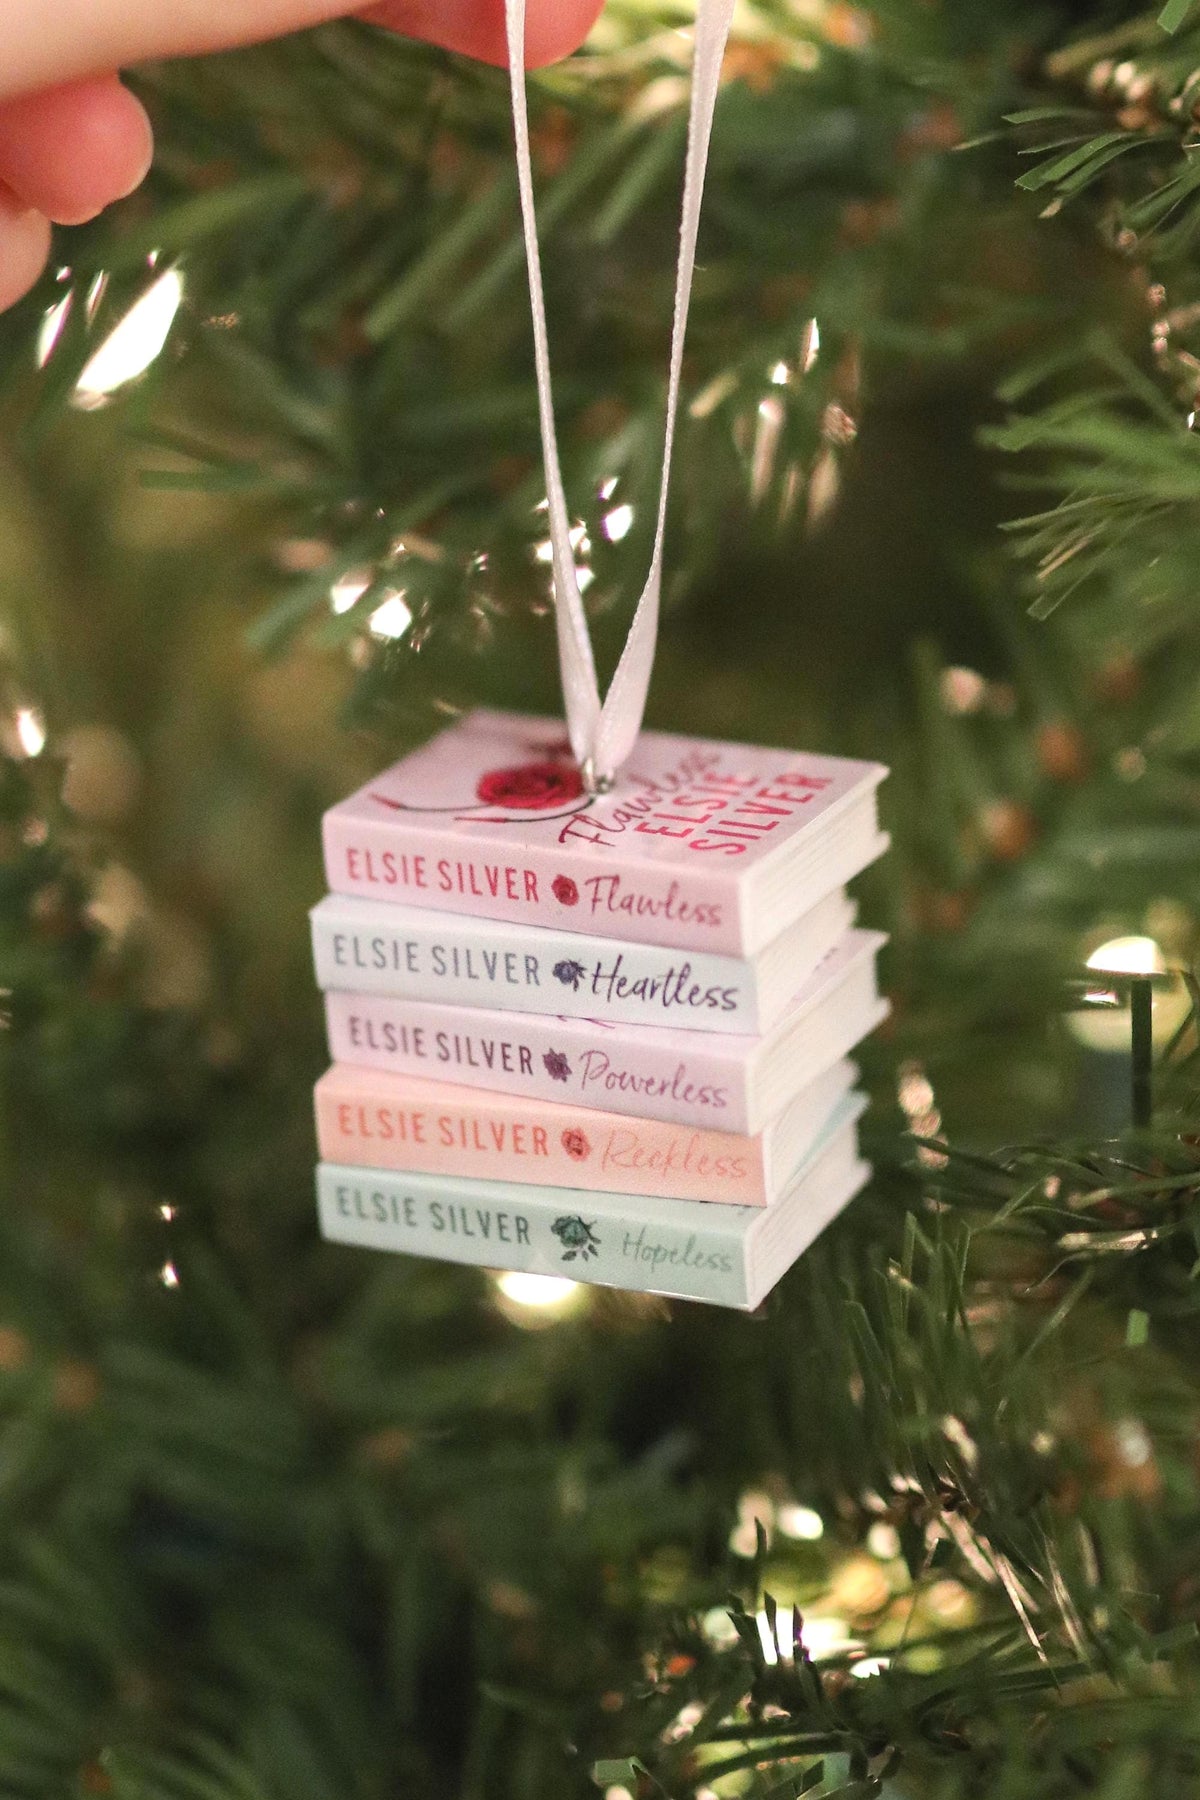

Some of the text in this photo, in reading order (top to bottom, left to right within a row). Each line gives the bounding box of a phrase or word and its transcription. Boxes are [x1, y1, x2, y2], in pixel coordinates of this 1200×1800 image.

[633, 771, 761, 839] ELSIE
[688, 772, 834, 856] SILVER
[346, 847, 722, 926] ELSIE SILVER Flawless
[333, 934, 739, 1012] ELSIE SILVER Heartless
[348, 1016, 729, 1109] ELSIE SILVER Powerless
[337, 1104, 748, 1180] ELSIE SILVER Reckless
[335, 1186, 735, 1274] ELSIE SILVER Hopeless
